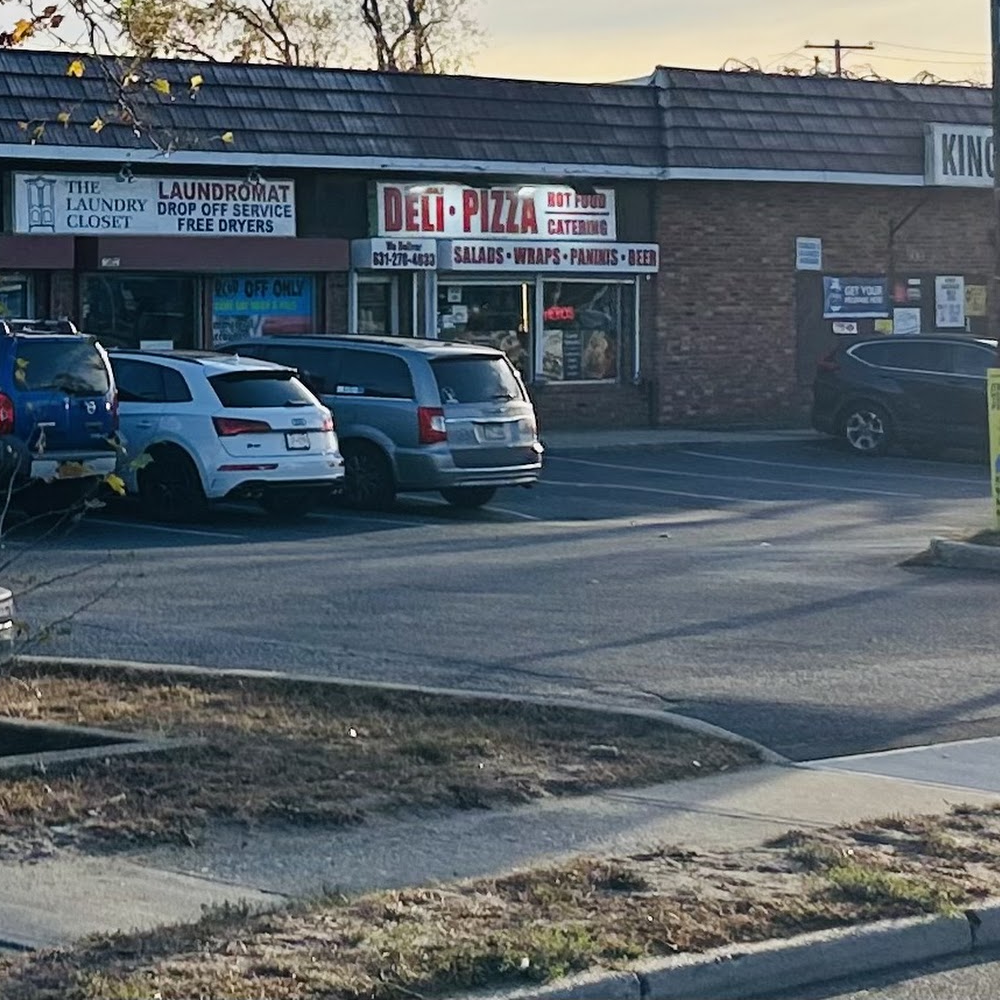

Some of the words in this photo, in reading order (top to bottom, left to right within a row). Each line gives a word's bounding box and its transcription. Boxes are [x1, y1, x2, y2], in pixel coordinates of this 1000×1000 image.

[66, 181, 99, 194] THE
[158, 181, 290, 202] LAUNDROMAT
[66, 199, 147, 212] LAUNDRY
[547, 191, 571, 208] HOT
[157, 202, 196, 216] DROP
[201, 203, 228, 217] OFF
[232, 205, 292, 218] SERVICE
[384, 187, 444, 232] DELI
[463, 189, 538, 234] PIZZA
[66, 215, 132, 228] CLOSET
[177, 219, 214, 232] FREE
[219, 220, 274, 233] DRYERS
[547, 219, 608, 236] CATERING
[454, 246, 504, 264] SALADS
[514, 247, 560, 265] WRAPS
[570, 248, 618, 266] PANINIS
[628, 249, 657, 267] BEER
[244, 279, 268, 298] OFF
